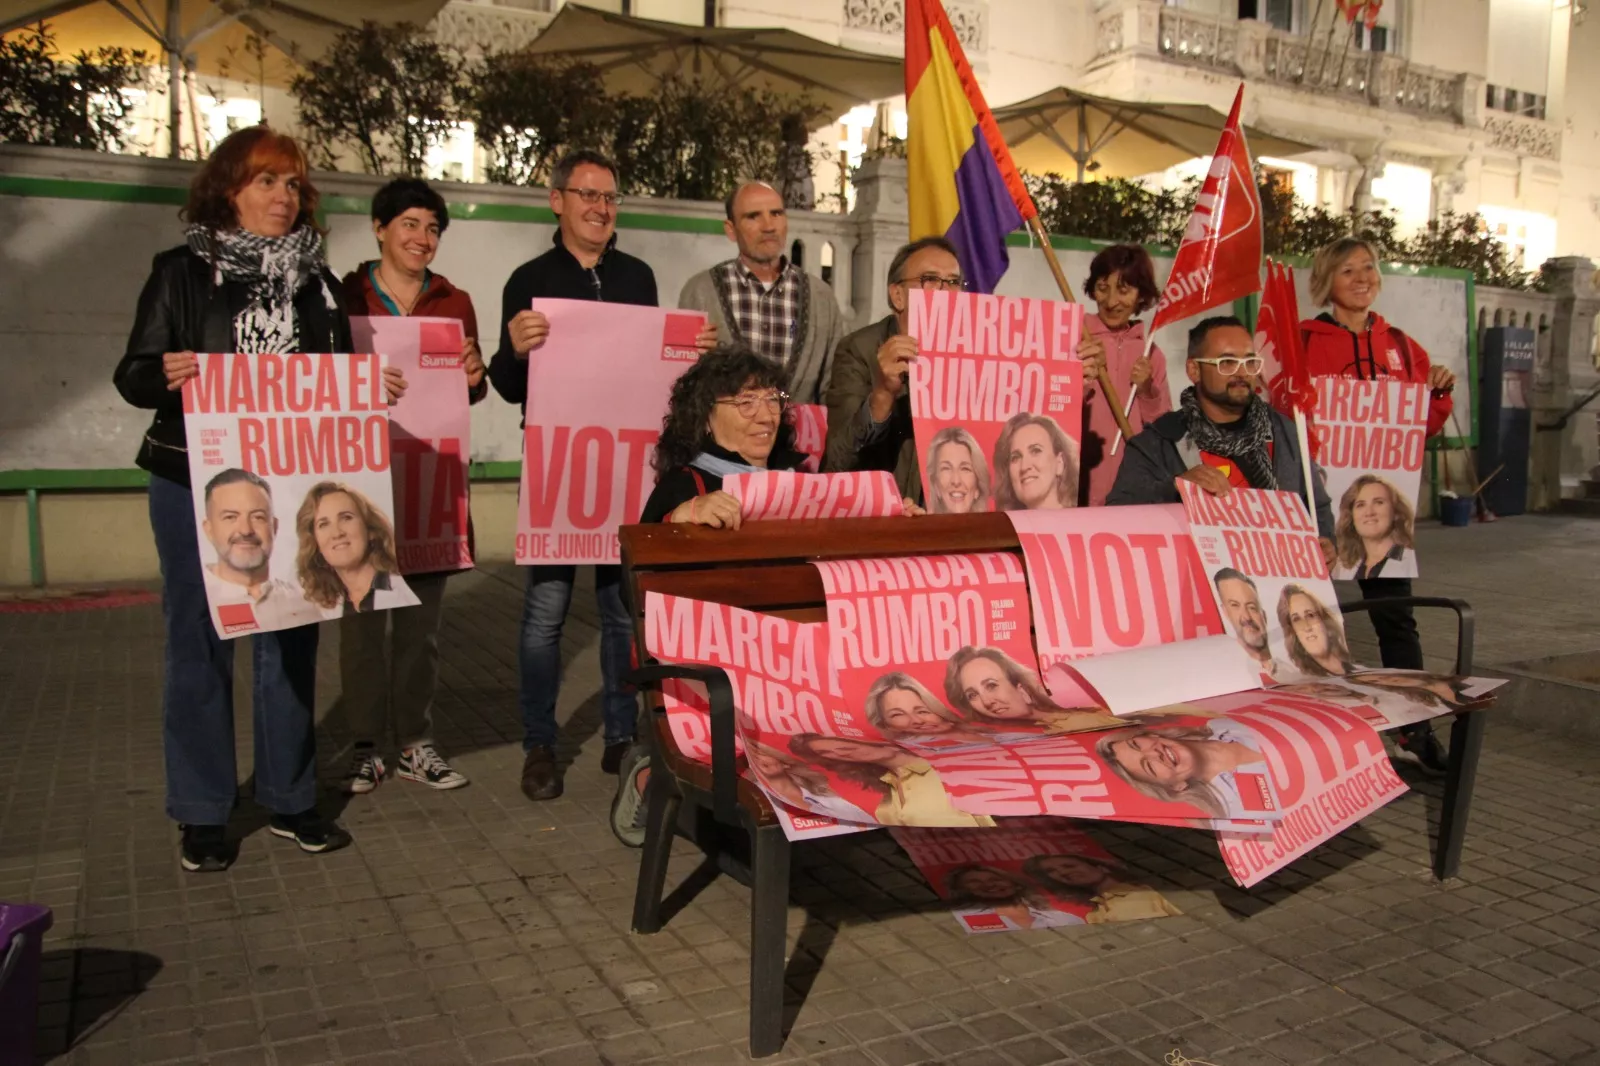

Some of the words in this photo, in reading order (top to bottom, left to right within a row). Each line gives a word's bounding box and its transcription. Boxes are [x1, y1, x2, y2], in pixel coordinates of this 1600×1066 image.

[908, 289, 1046, 360] MARCA
[181, 353, 341, 414] MARCA
[348, 353, 389, 411] EL
[909, 356, 1045, 422] RUMBO
[1313, 377, 1391, 424] ARCA
[1397, 382, 1428, 426] EL
[238, 415, 391, 477] RUMBO
[1313, 424, 1425, 472] RUMBO
[391, 437, 468, 540] TA
[524, 425, 661, 531] VOT
[1175, 477, 1285, 529] MARCA
[1274, 489, 1315, 532] EL
[515, 533, 527, 560] 9
[530, 534, 550, 560] DE
[819, 557, 980, 594] MARCA
[980, 553, 1025, 585] EL
[1222, 530, 1329, 581] RUMBO
[645, 591, 820, 691] MARCA
[828, 590, 987, 670] RUMBO
[1225, 697, 1385, 810] OTA
[1228, 845, 1250, 880] 9
[1240, 832, 1275, 872] DE
